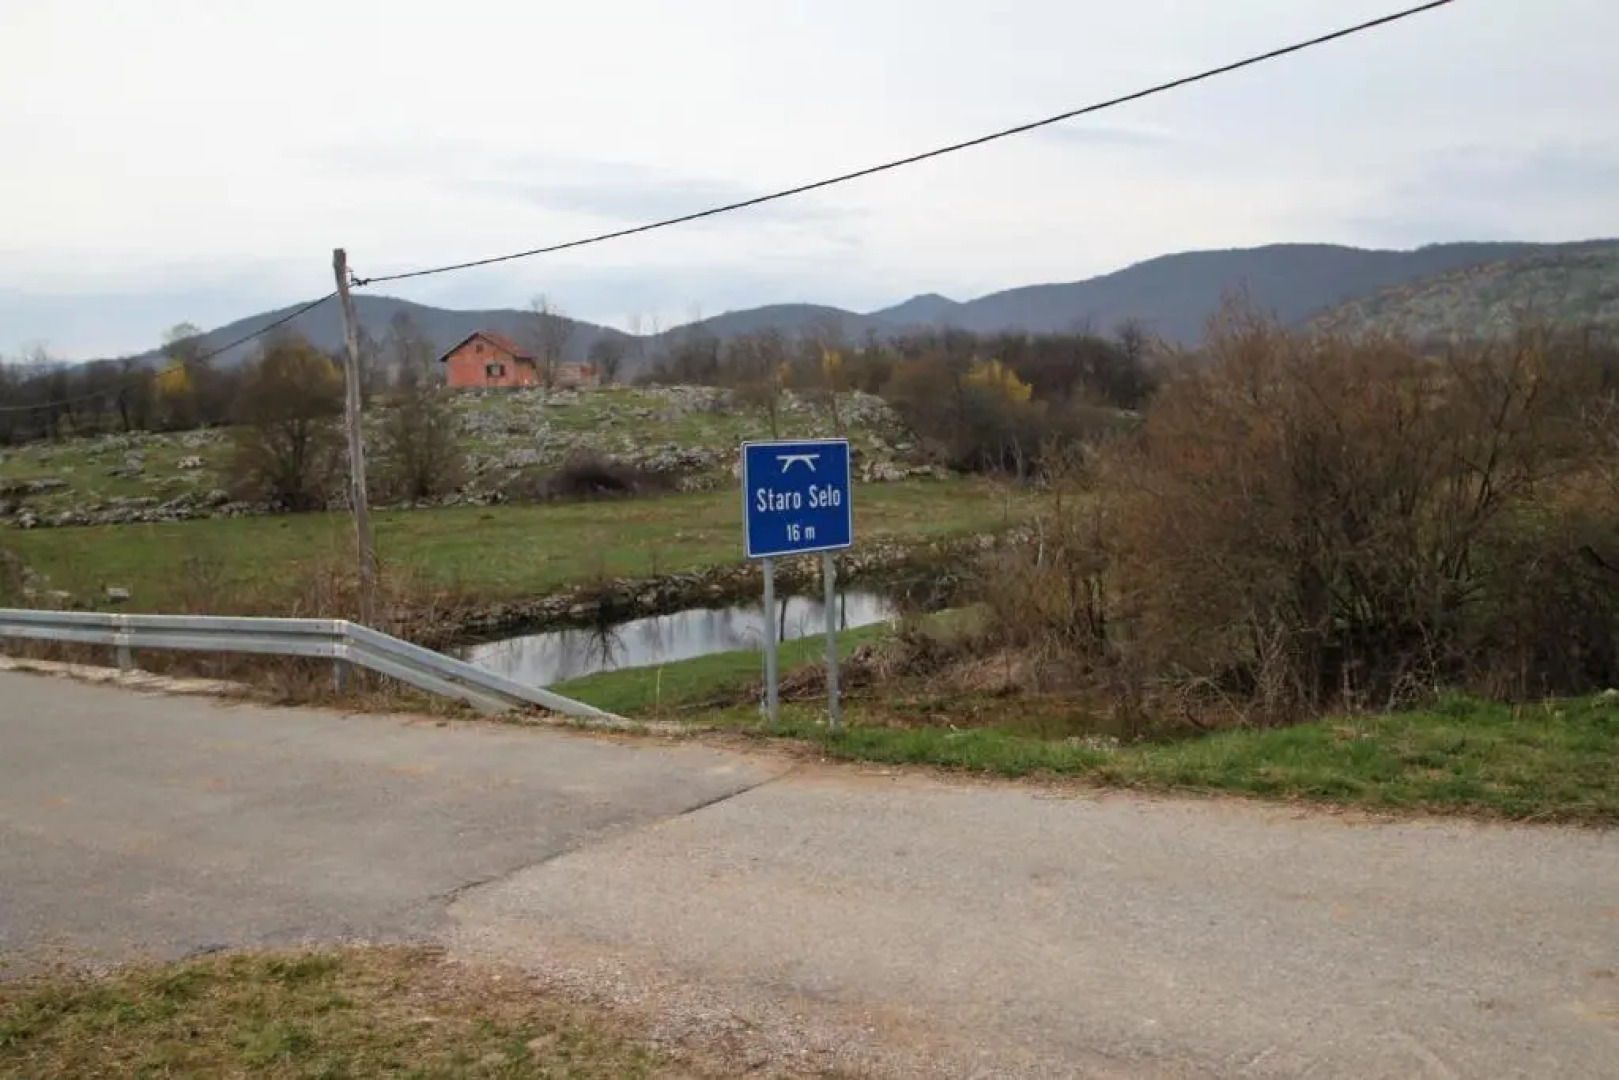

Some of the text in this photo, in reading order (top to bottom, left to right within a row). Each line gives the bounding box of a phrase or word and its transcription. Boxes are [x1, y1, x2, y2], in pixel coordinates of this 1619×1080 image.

[756, 484, 841, 512] Staro Selo
[786, 524, 816, 541] 16 m
